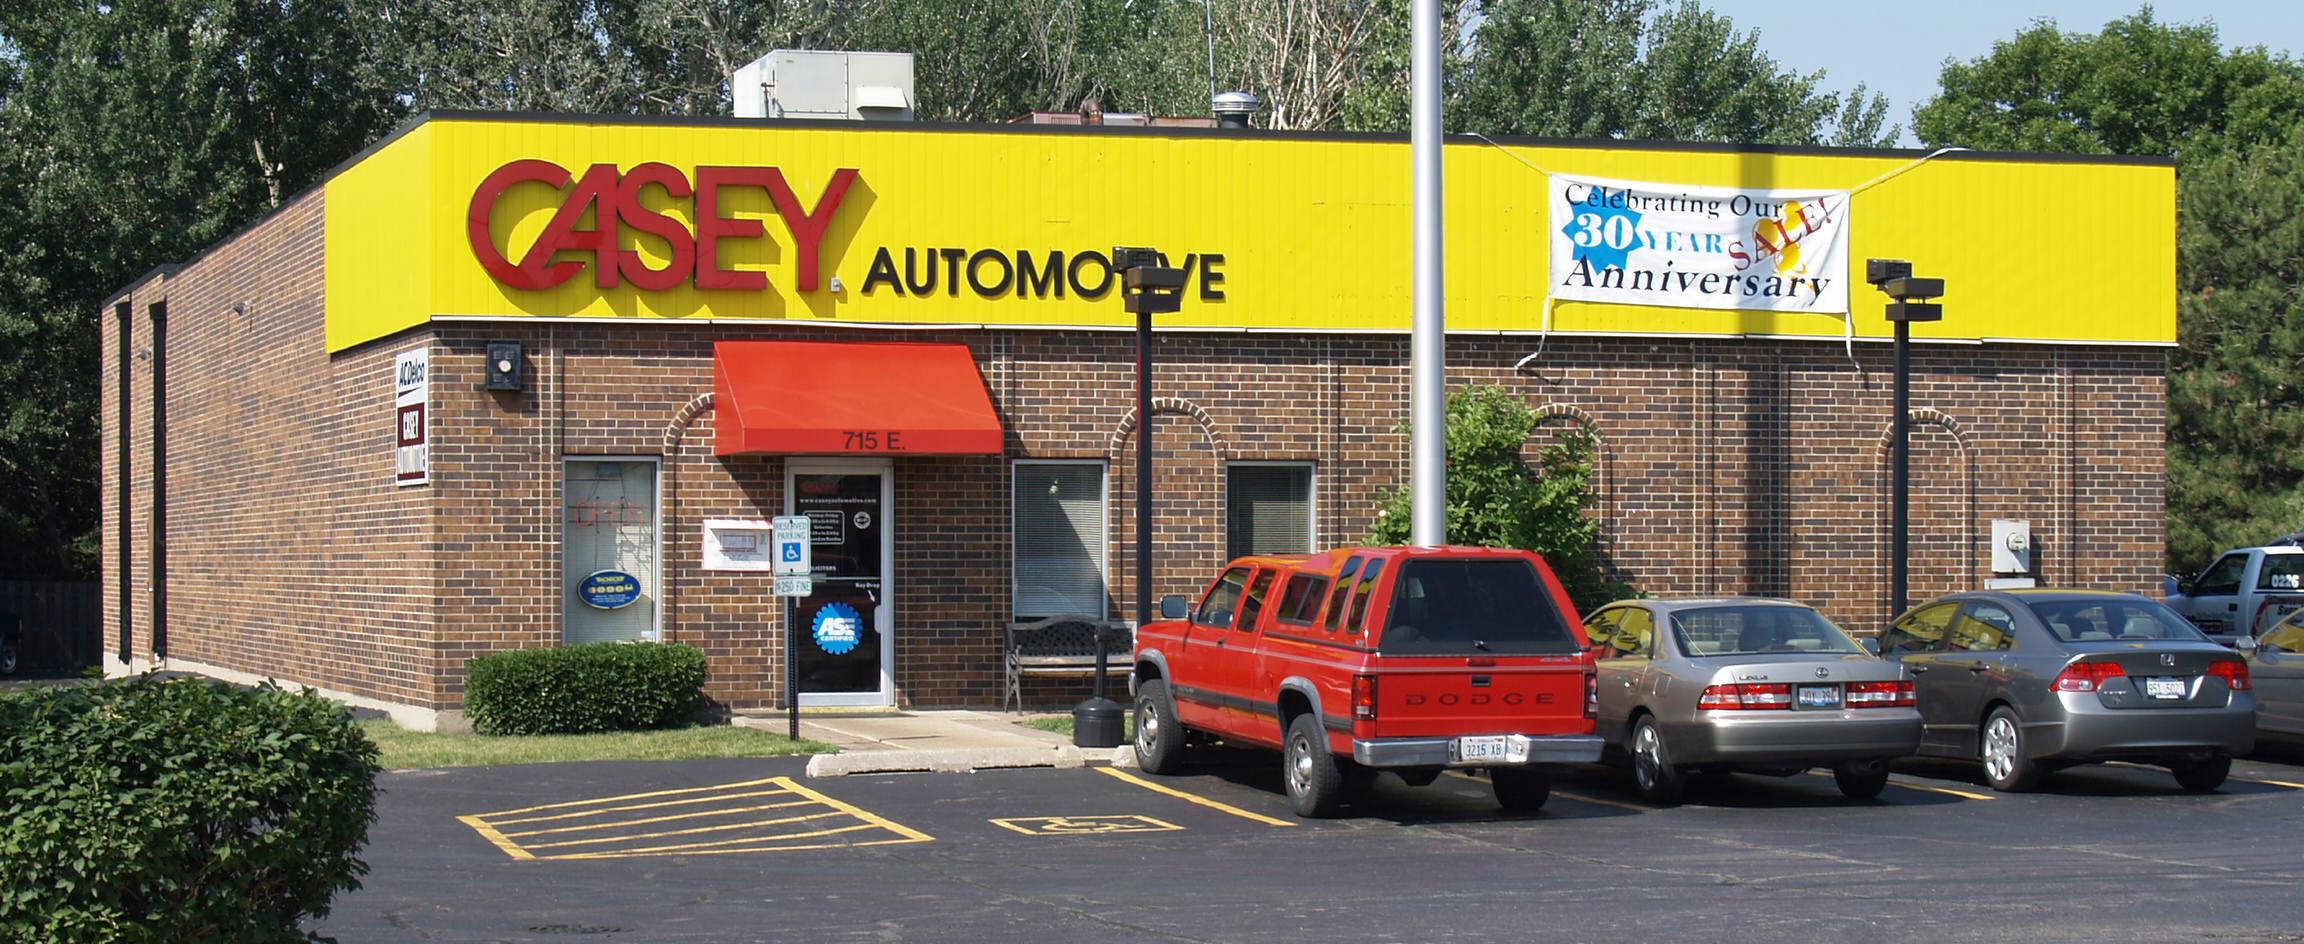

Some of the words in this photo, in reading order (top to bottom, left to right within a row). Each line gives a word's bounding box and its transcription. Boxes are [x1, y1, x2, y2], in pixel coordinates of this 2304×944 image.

[1564, 183, 1721, 219] Celebrating
[1729, 194, 1783, 218] Our
[467, 158, 860, 291] CASEY
[1573, 212, 1635, 251] 30
[1644, 230, 1724, 254] YEAR
[1728, 197, 1833, 272] SALE!
[861, 246, 1226, 301] AUTOMOVE
[1562, 254, 1832, 307] Anniversary
[842, 431, 878, 450] 715
[887, 431, 906, 450] E.
[818, 617, 856, 636] ASE
[1405, 692, 1555, 706] DODGE
[1465, 743, 1487, 757] 3215
